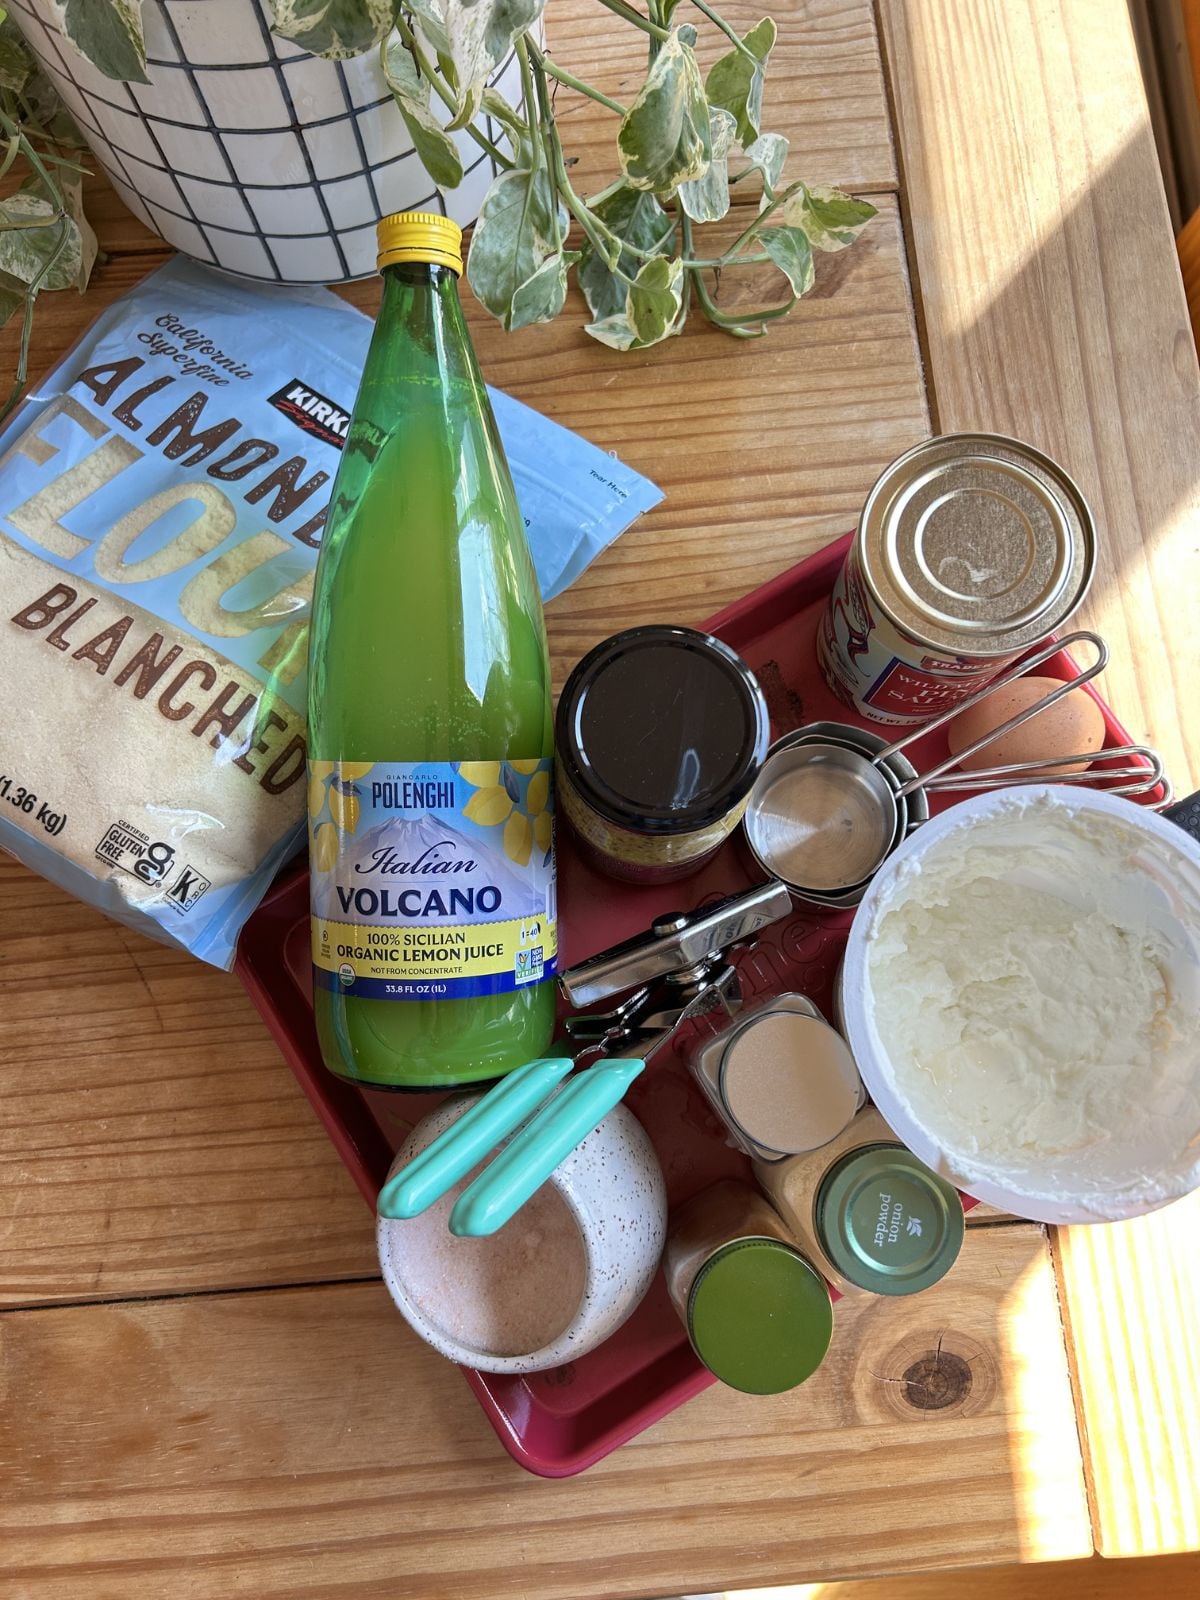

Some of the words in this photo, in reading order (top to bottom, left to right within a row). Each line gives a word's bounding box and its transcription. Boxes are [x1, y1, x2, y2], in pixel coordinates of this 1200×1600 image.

[137, 332, 231, 387] Superfine
[155, 313, 254, 381] California
[589, 469, 607, 484] Tear
[607, 481, 628, 498] Here
[0, 391, 316, 687] FLOU
[11, 582, 306, 795] BLANCHED
[372, 782, 455, 809] POLENGHI
[36, 802, 67, 836] kg)
[118, 820, 150, 841] CERTIFIED
[100, 840, 125, 861] FREE
[109, 830, 147, 858] GLUTEN
[355, 841, 478, 875] Italian
[336, 885, 502, 917] VOLCANO
[337, 944, 399, 962] ORGANIC
[403, 946, 461, 962] LEMON
[464, 943, 504, 962] JUICE
[366, 932, 401, 946] 100%
[404, 932, 466, 946] SICILIAN
[408, 967, 463, 975] CONCENTRATE
[385, 985, 404, 993] 33.8
[405, 985, 415, 993] FL
[431, 984, 447, 993] (1L)
[873, 1192, 891, 1247] powder
[888, 1203, 903, 1243] onion
